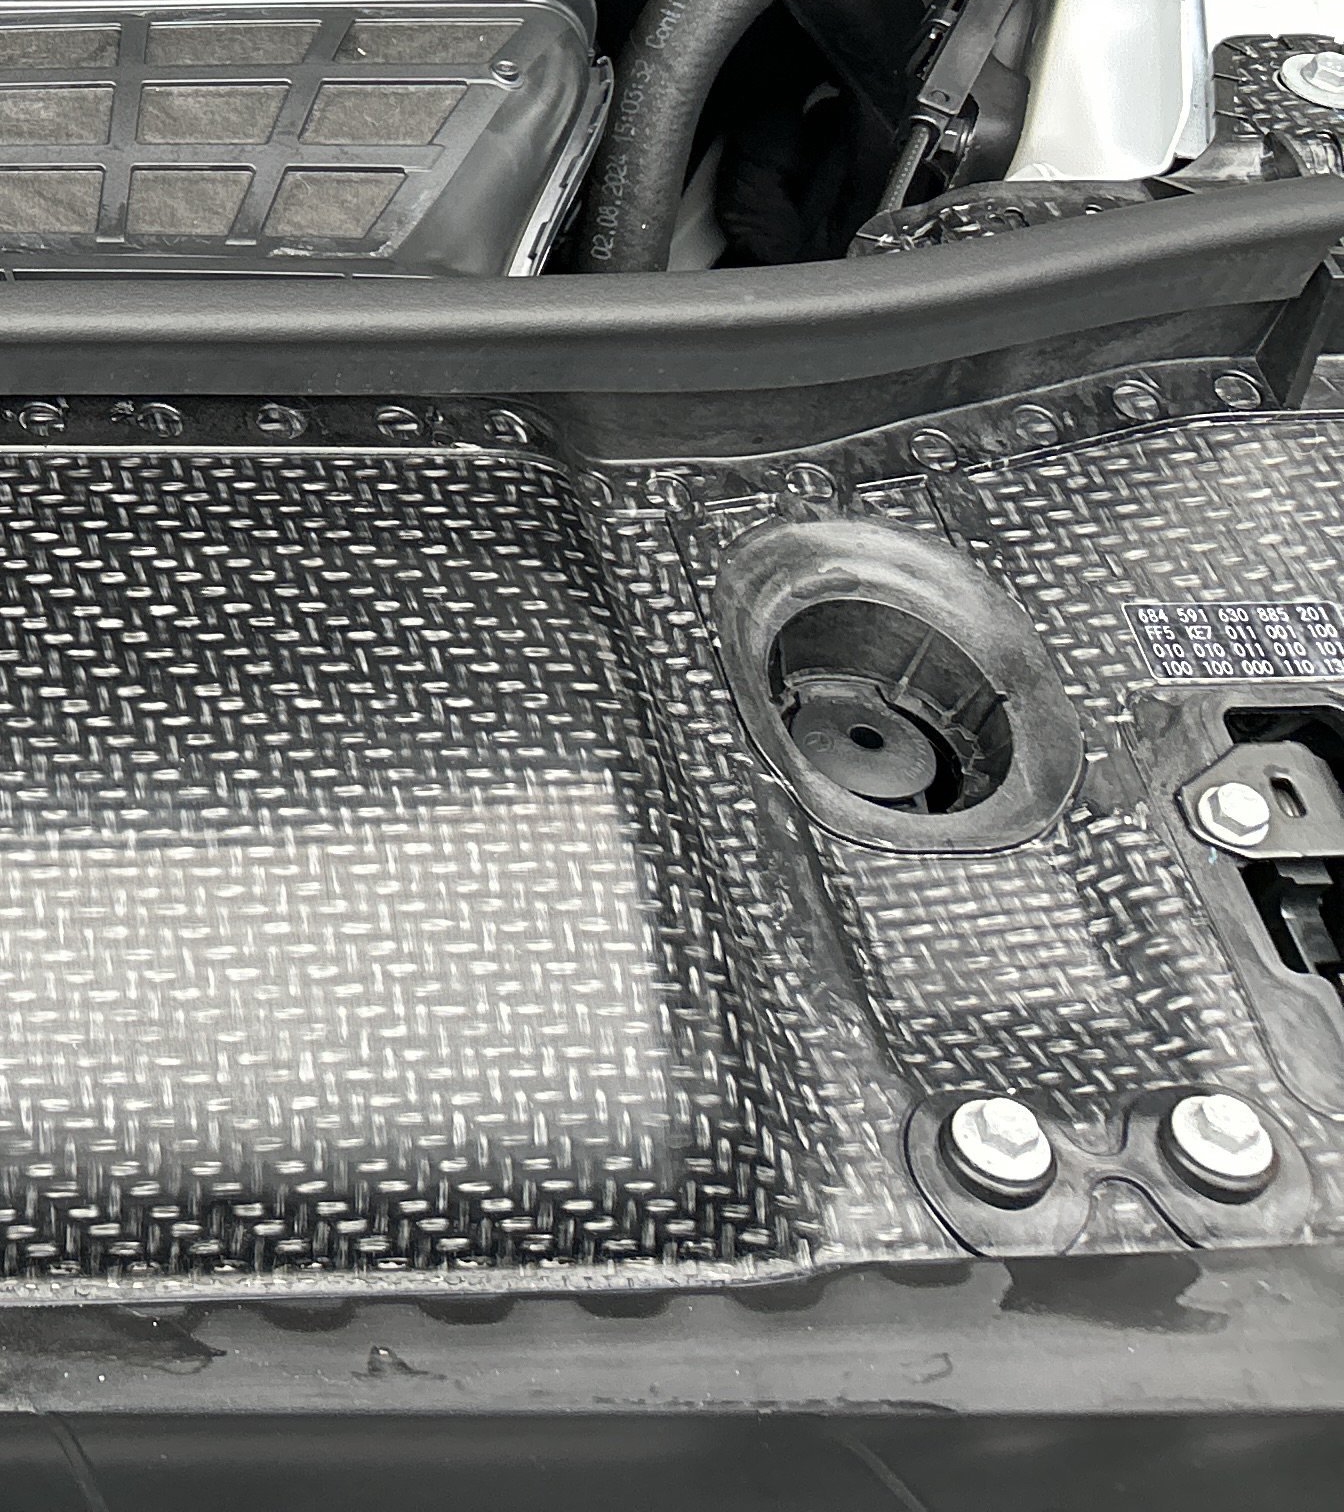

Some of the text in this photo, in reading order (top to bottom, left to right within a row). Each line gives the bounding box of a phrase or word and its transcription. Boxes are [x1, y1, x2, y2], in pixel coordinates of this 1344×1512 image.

[1137, 606, 1330, 624] 684 591 630 885 201
[1144, 623, 1339, 641] FF5 KE7 011 001 100
[1152, 642, 1186, 659] 010
[1192, 642, 1226, 658] 010
[1232, 642, 1266, 658] 011
[1273, 641, 1307, 657] 010
[1161, 658, 1344, 677] 100 100 000 110 13
